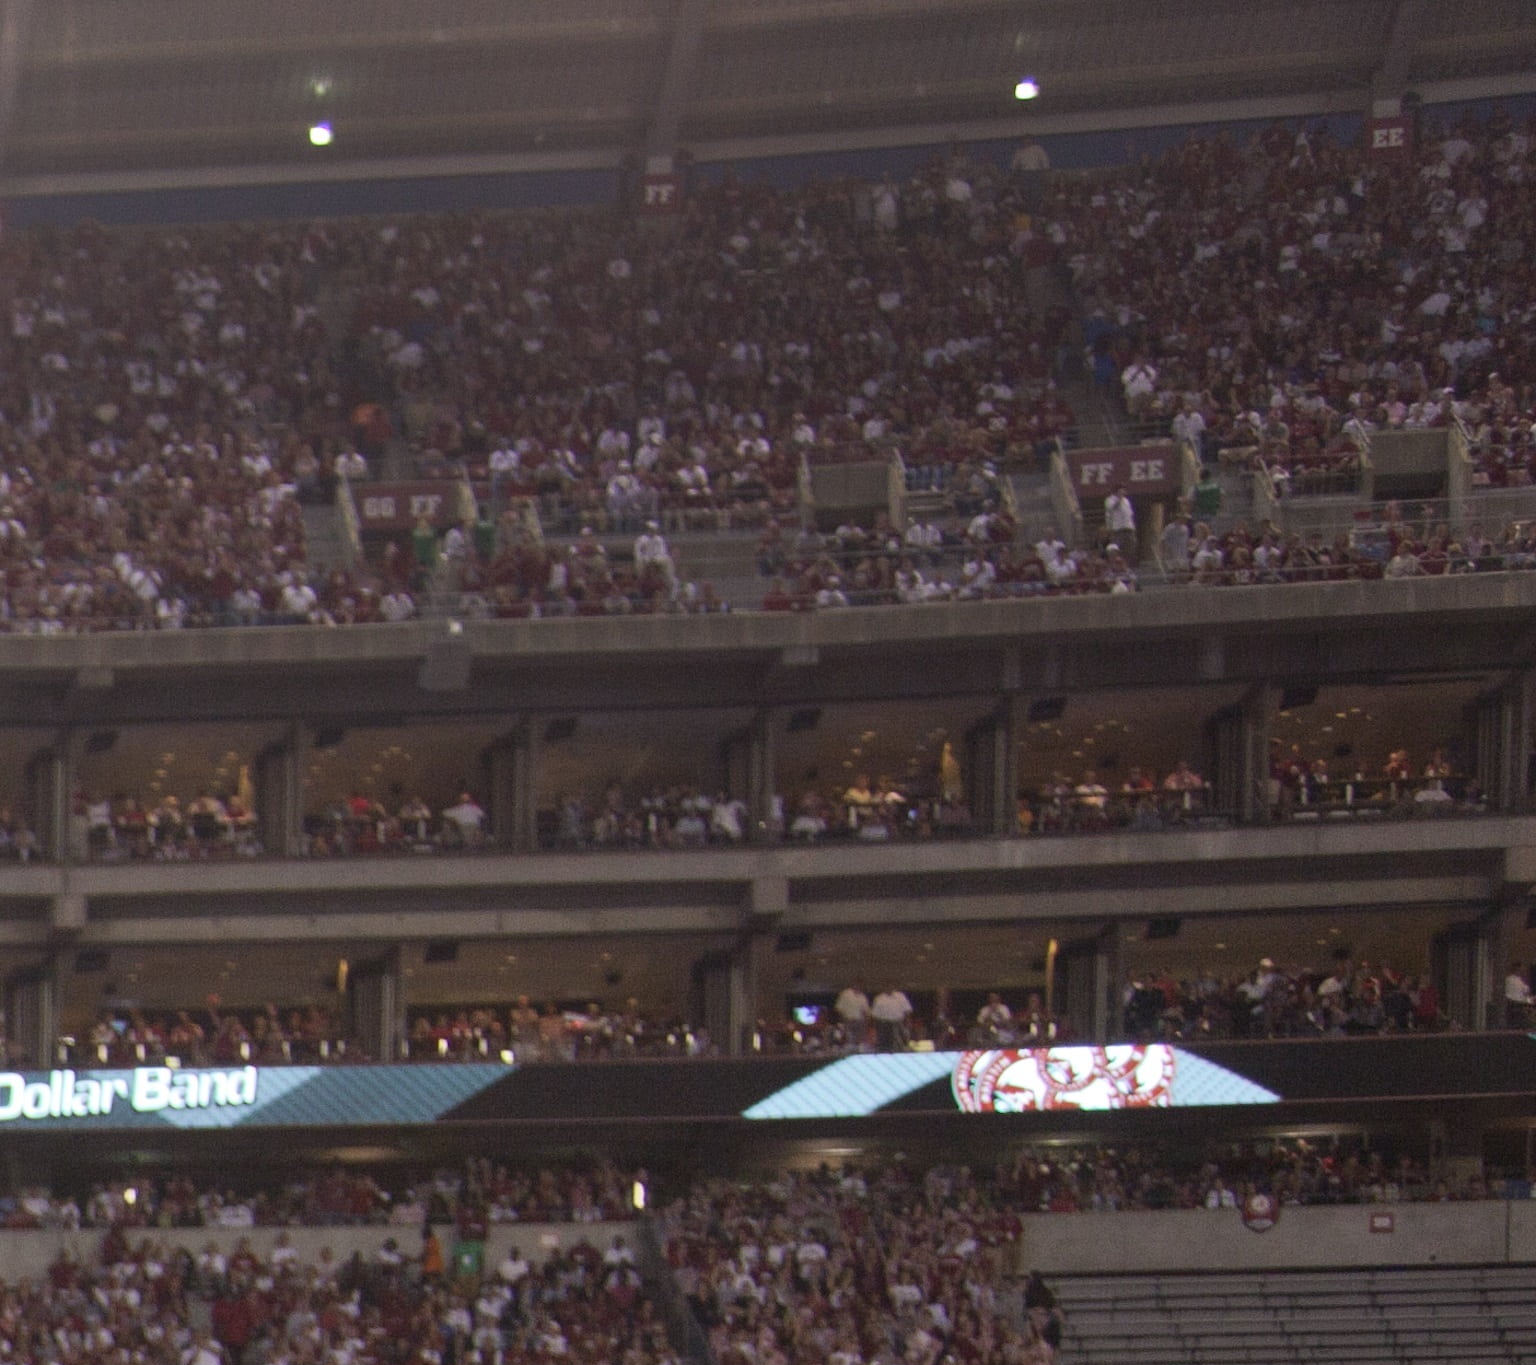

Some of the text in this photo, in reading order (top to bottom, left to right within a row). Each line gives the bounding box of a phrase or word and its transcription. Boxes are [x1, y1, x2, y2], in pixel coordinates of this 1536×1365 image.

[1372, 127, 1405, 149] EE
[644, 184, 674, 205] FF
[1080, 460, 1163, 485] FF EE
[363, 495, 442, 520] GG FF
[130, 1066, 258, 1113] Band
